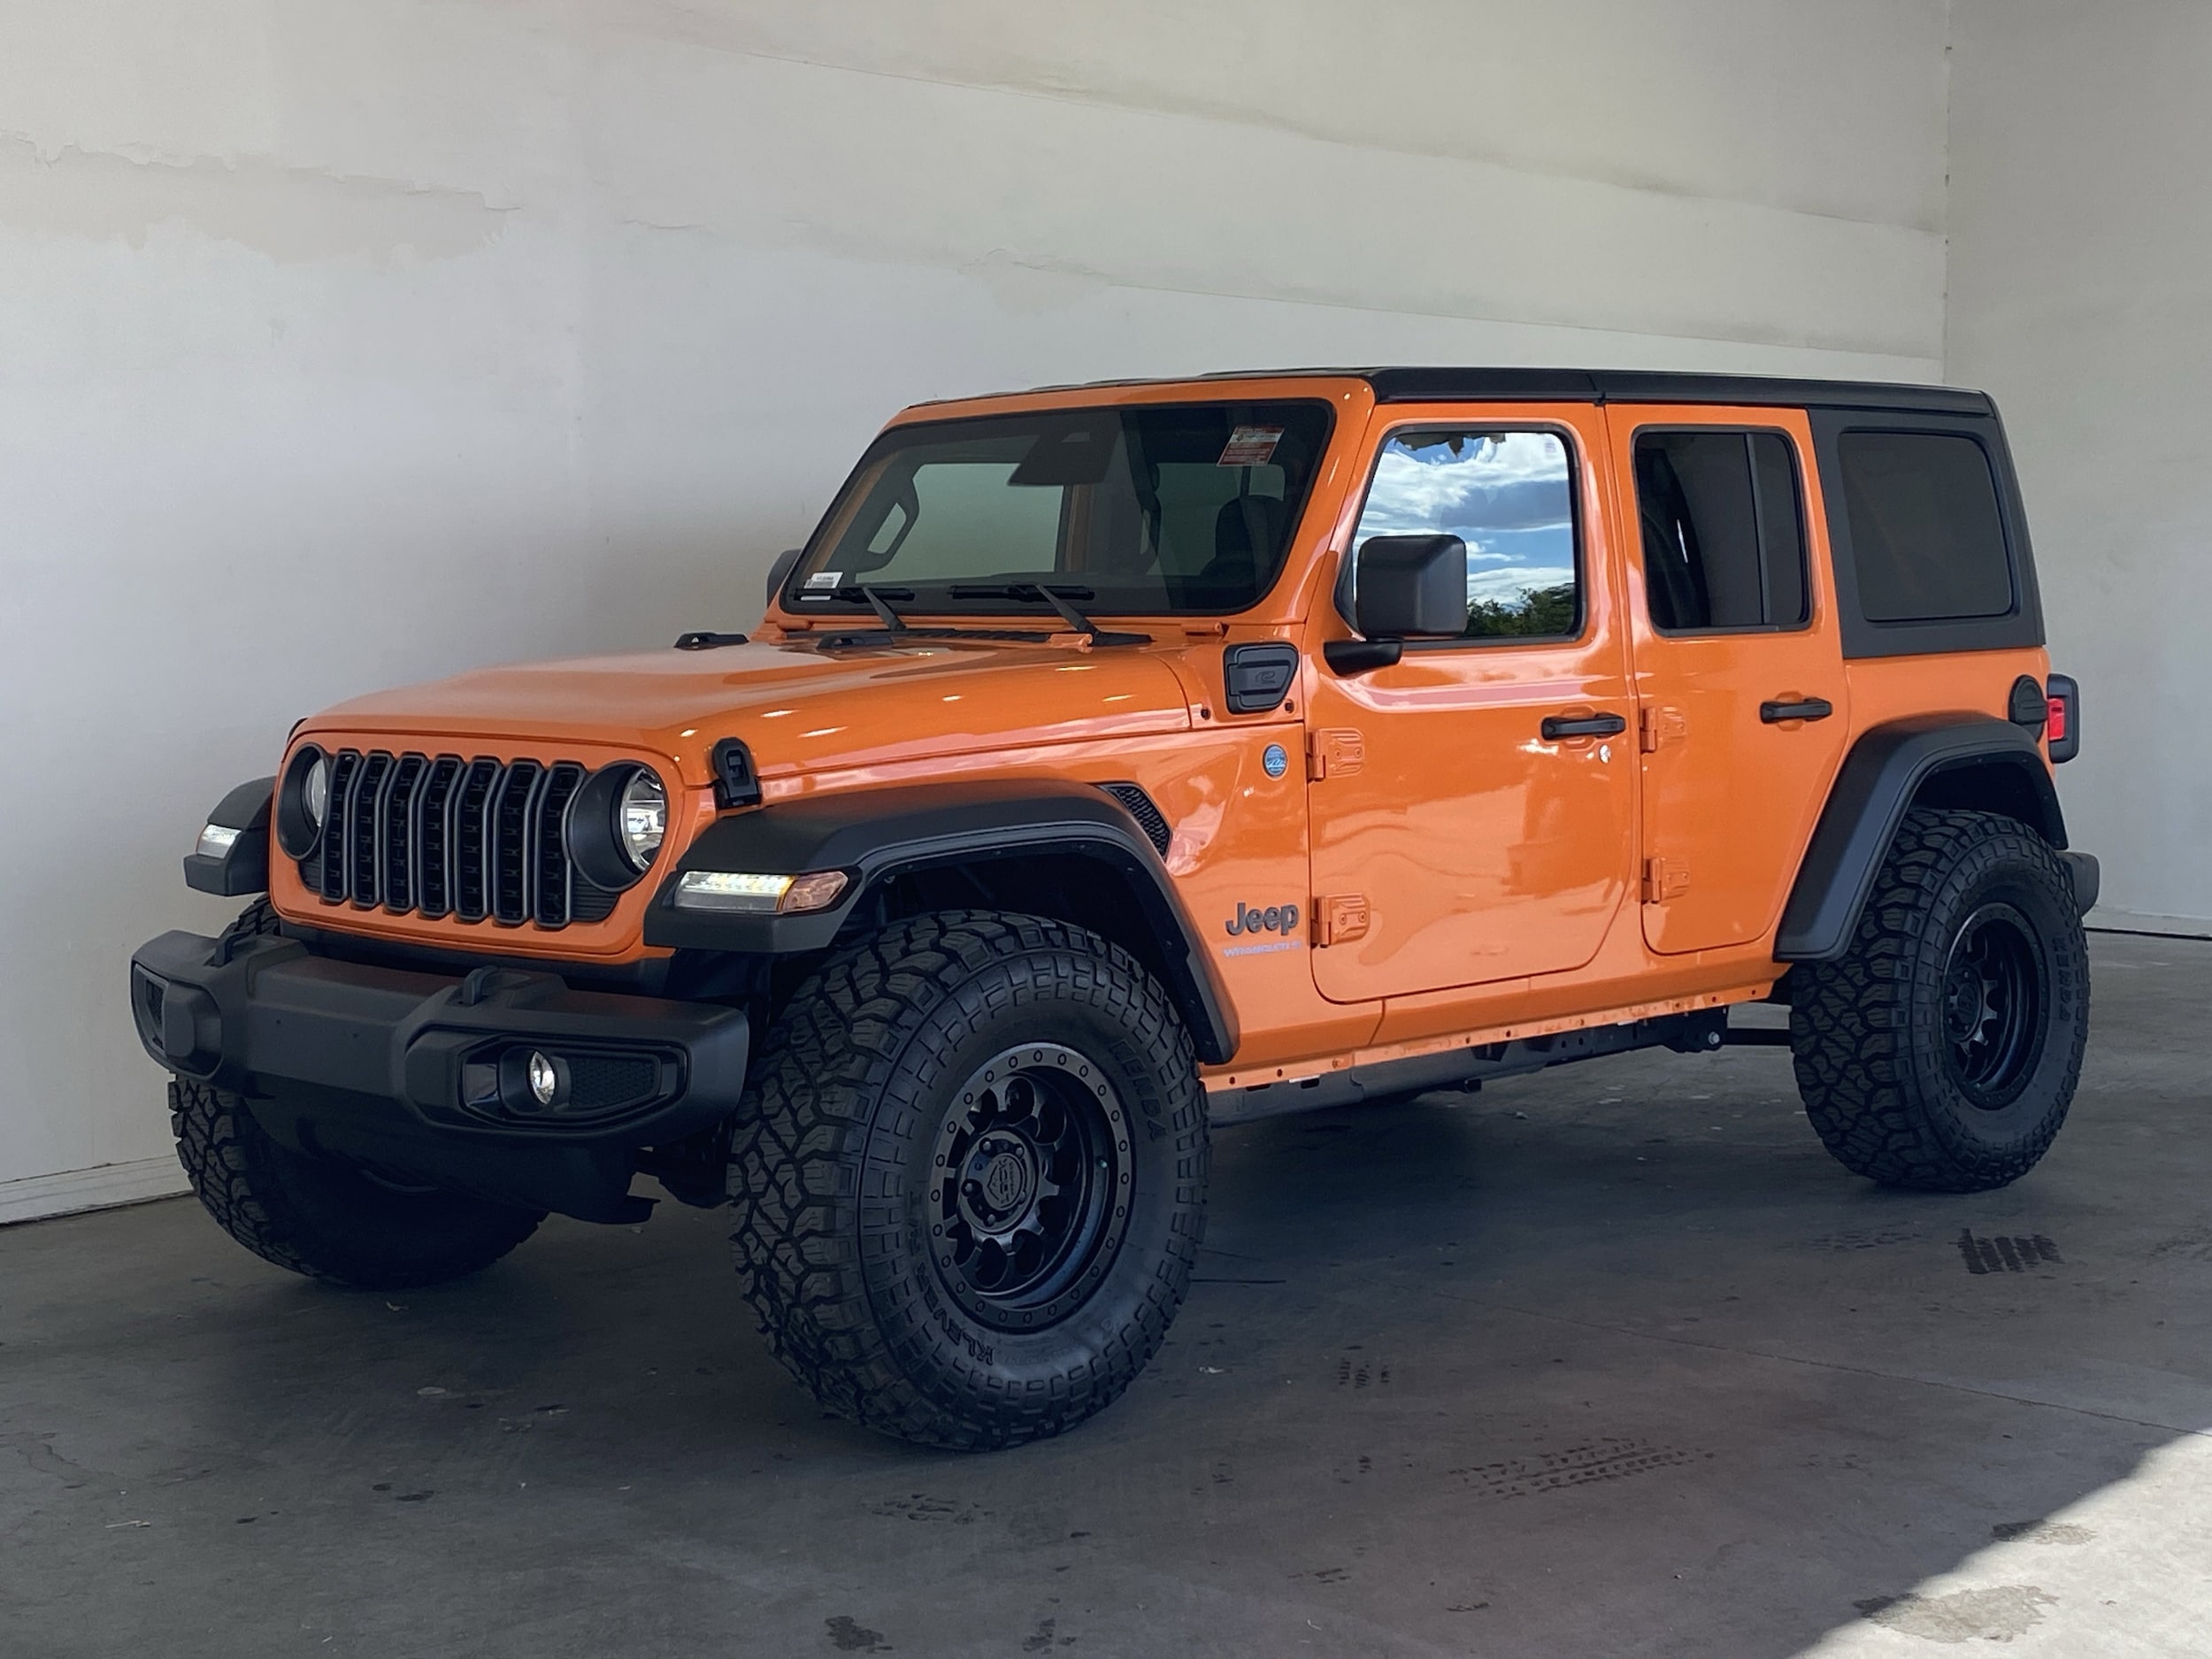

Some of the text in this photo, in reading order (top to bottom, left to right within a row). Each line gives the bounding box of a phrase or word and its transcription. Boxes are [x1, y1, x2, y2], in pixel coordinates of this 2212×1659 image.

[1225, 902, 1298, 935] Jeep
[1108, 1039, 1168, 1142] KENDA
[915, 1263, 996, 1365] KLEVER
